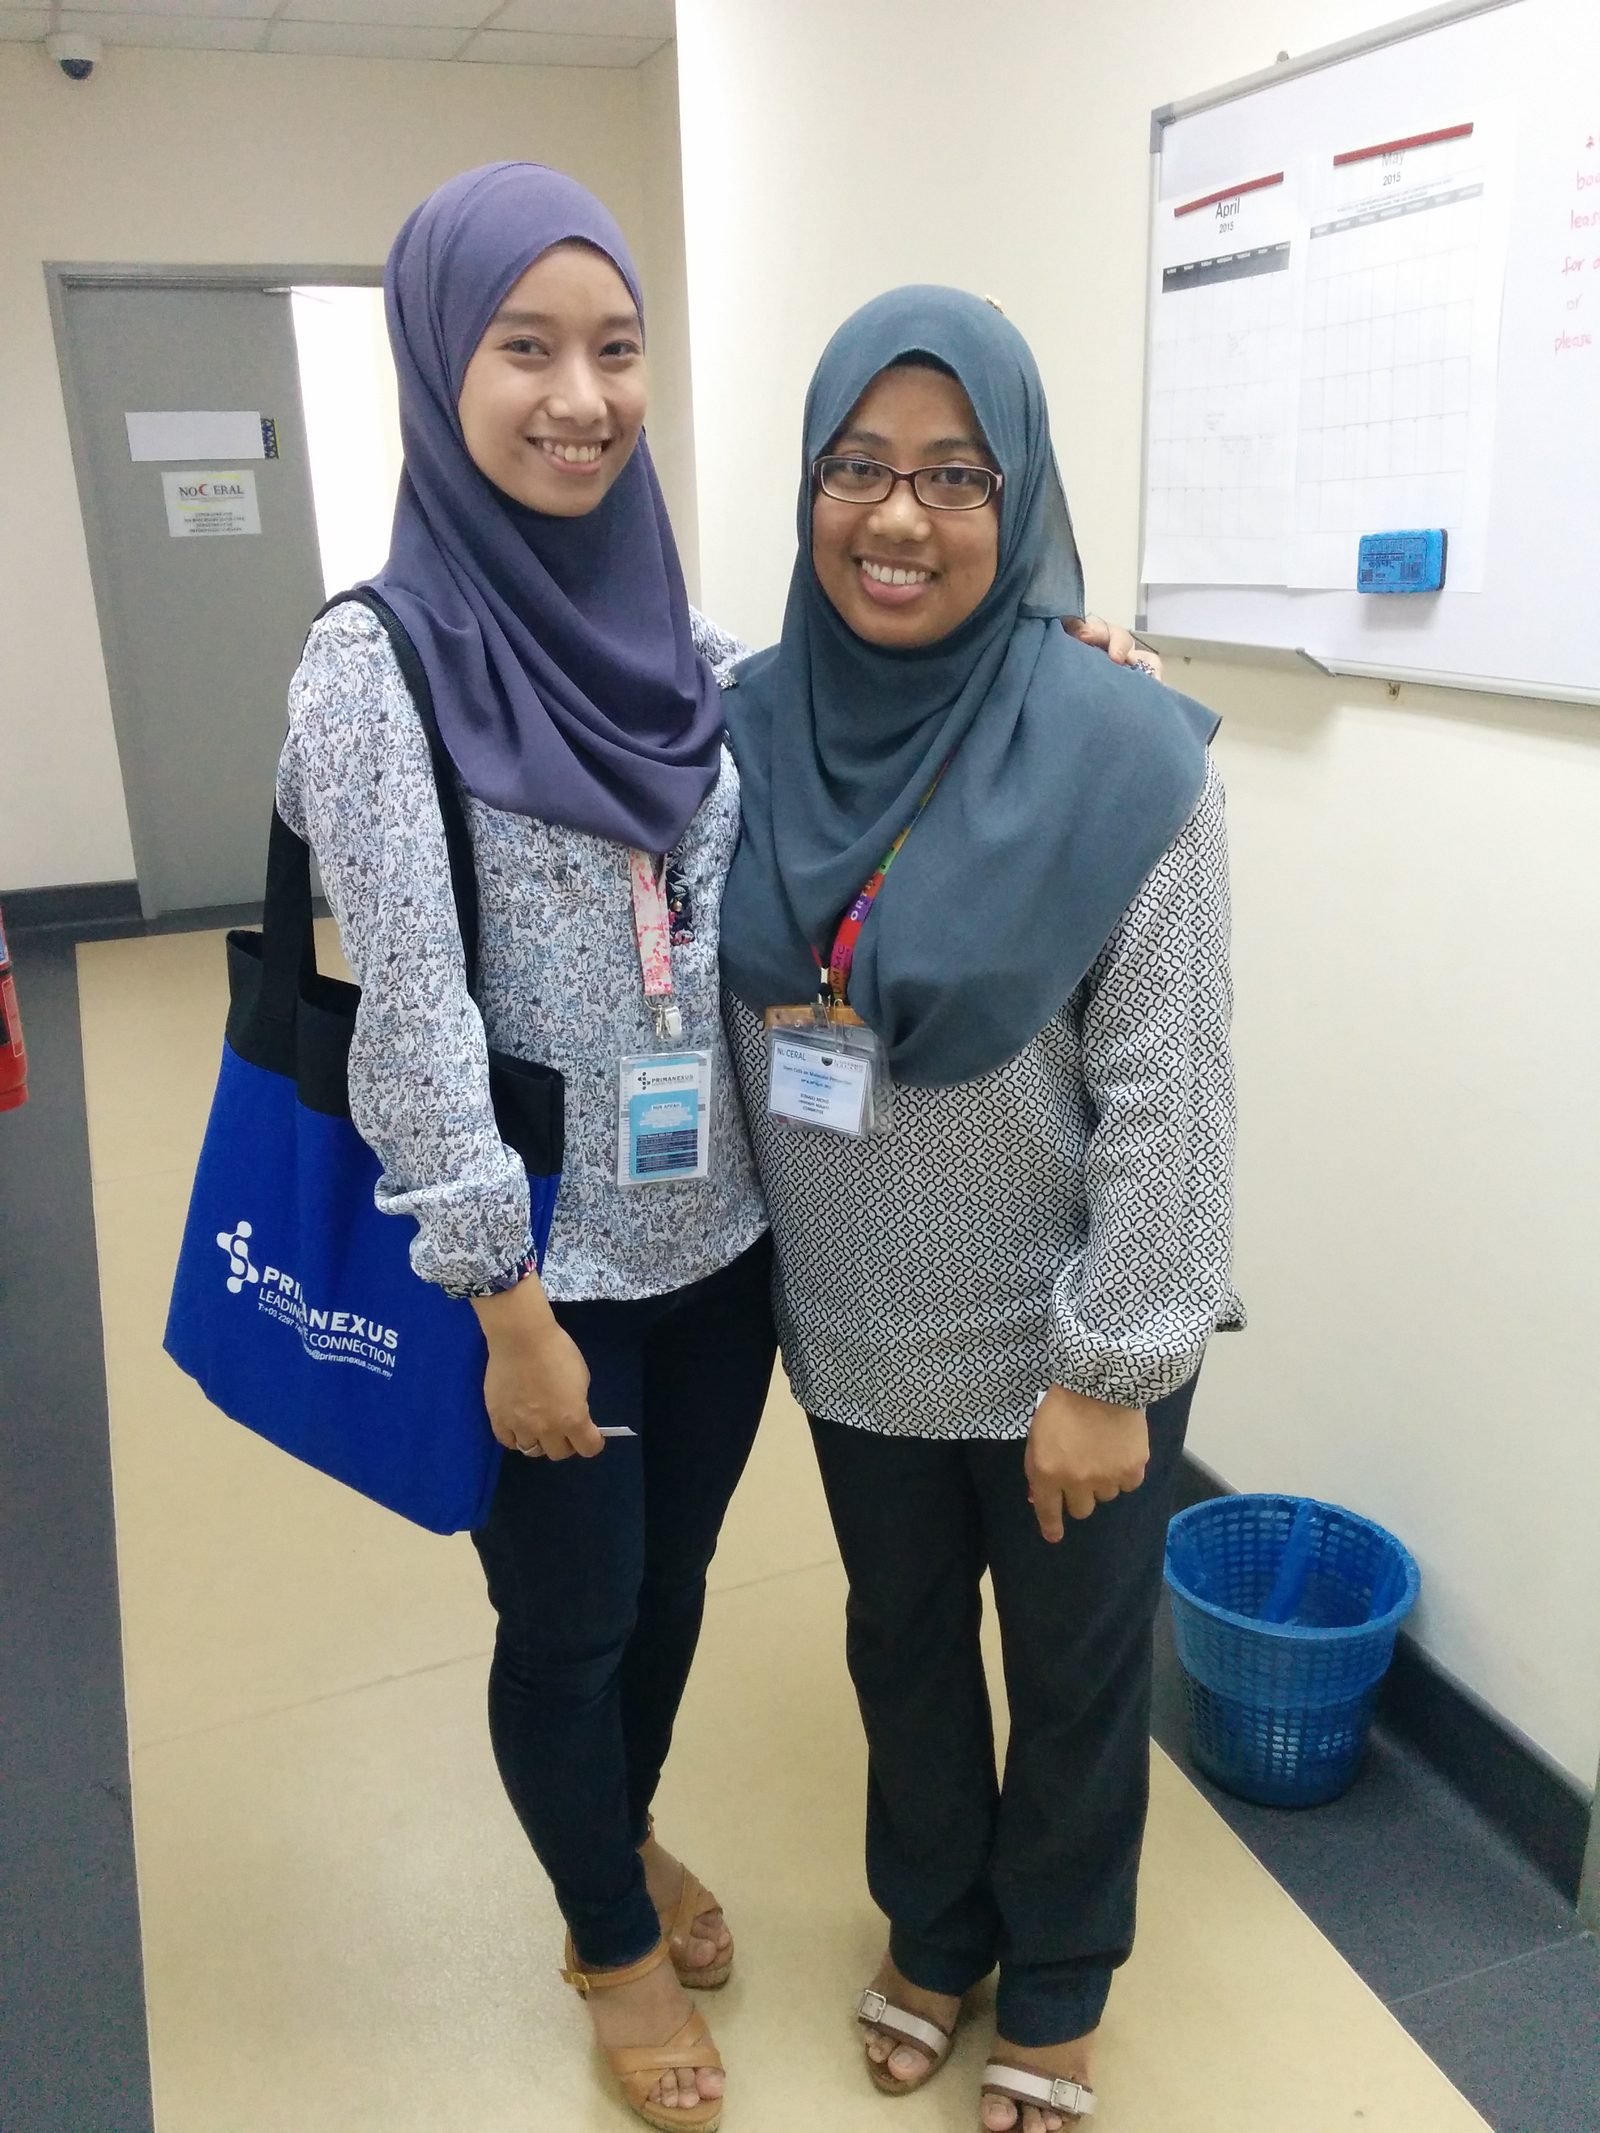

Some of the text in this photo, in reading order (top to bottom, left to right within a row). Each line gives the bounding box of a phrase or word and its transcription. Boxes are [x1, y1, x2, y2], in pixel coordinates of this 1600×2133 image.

[1381, 150, 1406, 168] May
[1382, 172, 1402, 186] 2015
[1215, 197, 1241, 219] April
[1219, 221, 1235, 234] 2015
[1570, 208, 1600, 231] leas
[1562, 256, 1585, 276] for
[1554, 329, 1593, 355] please
[834, 944, 846, 996] UMMC
[651, 1075, 694, 1084] PRIMANEXUS
[309, 1333, 396, 1368] CONNECTION
